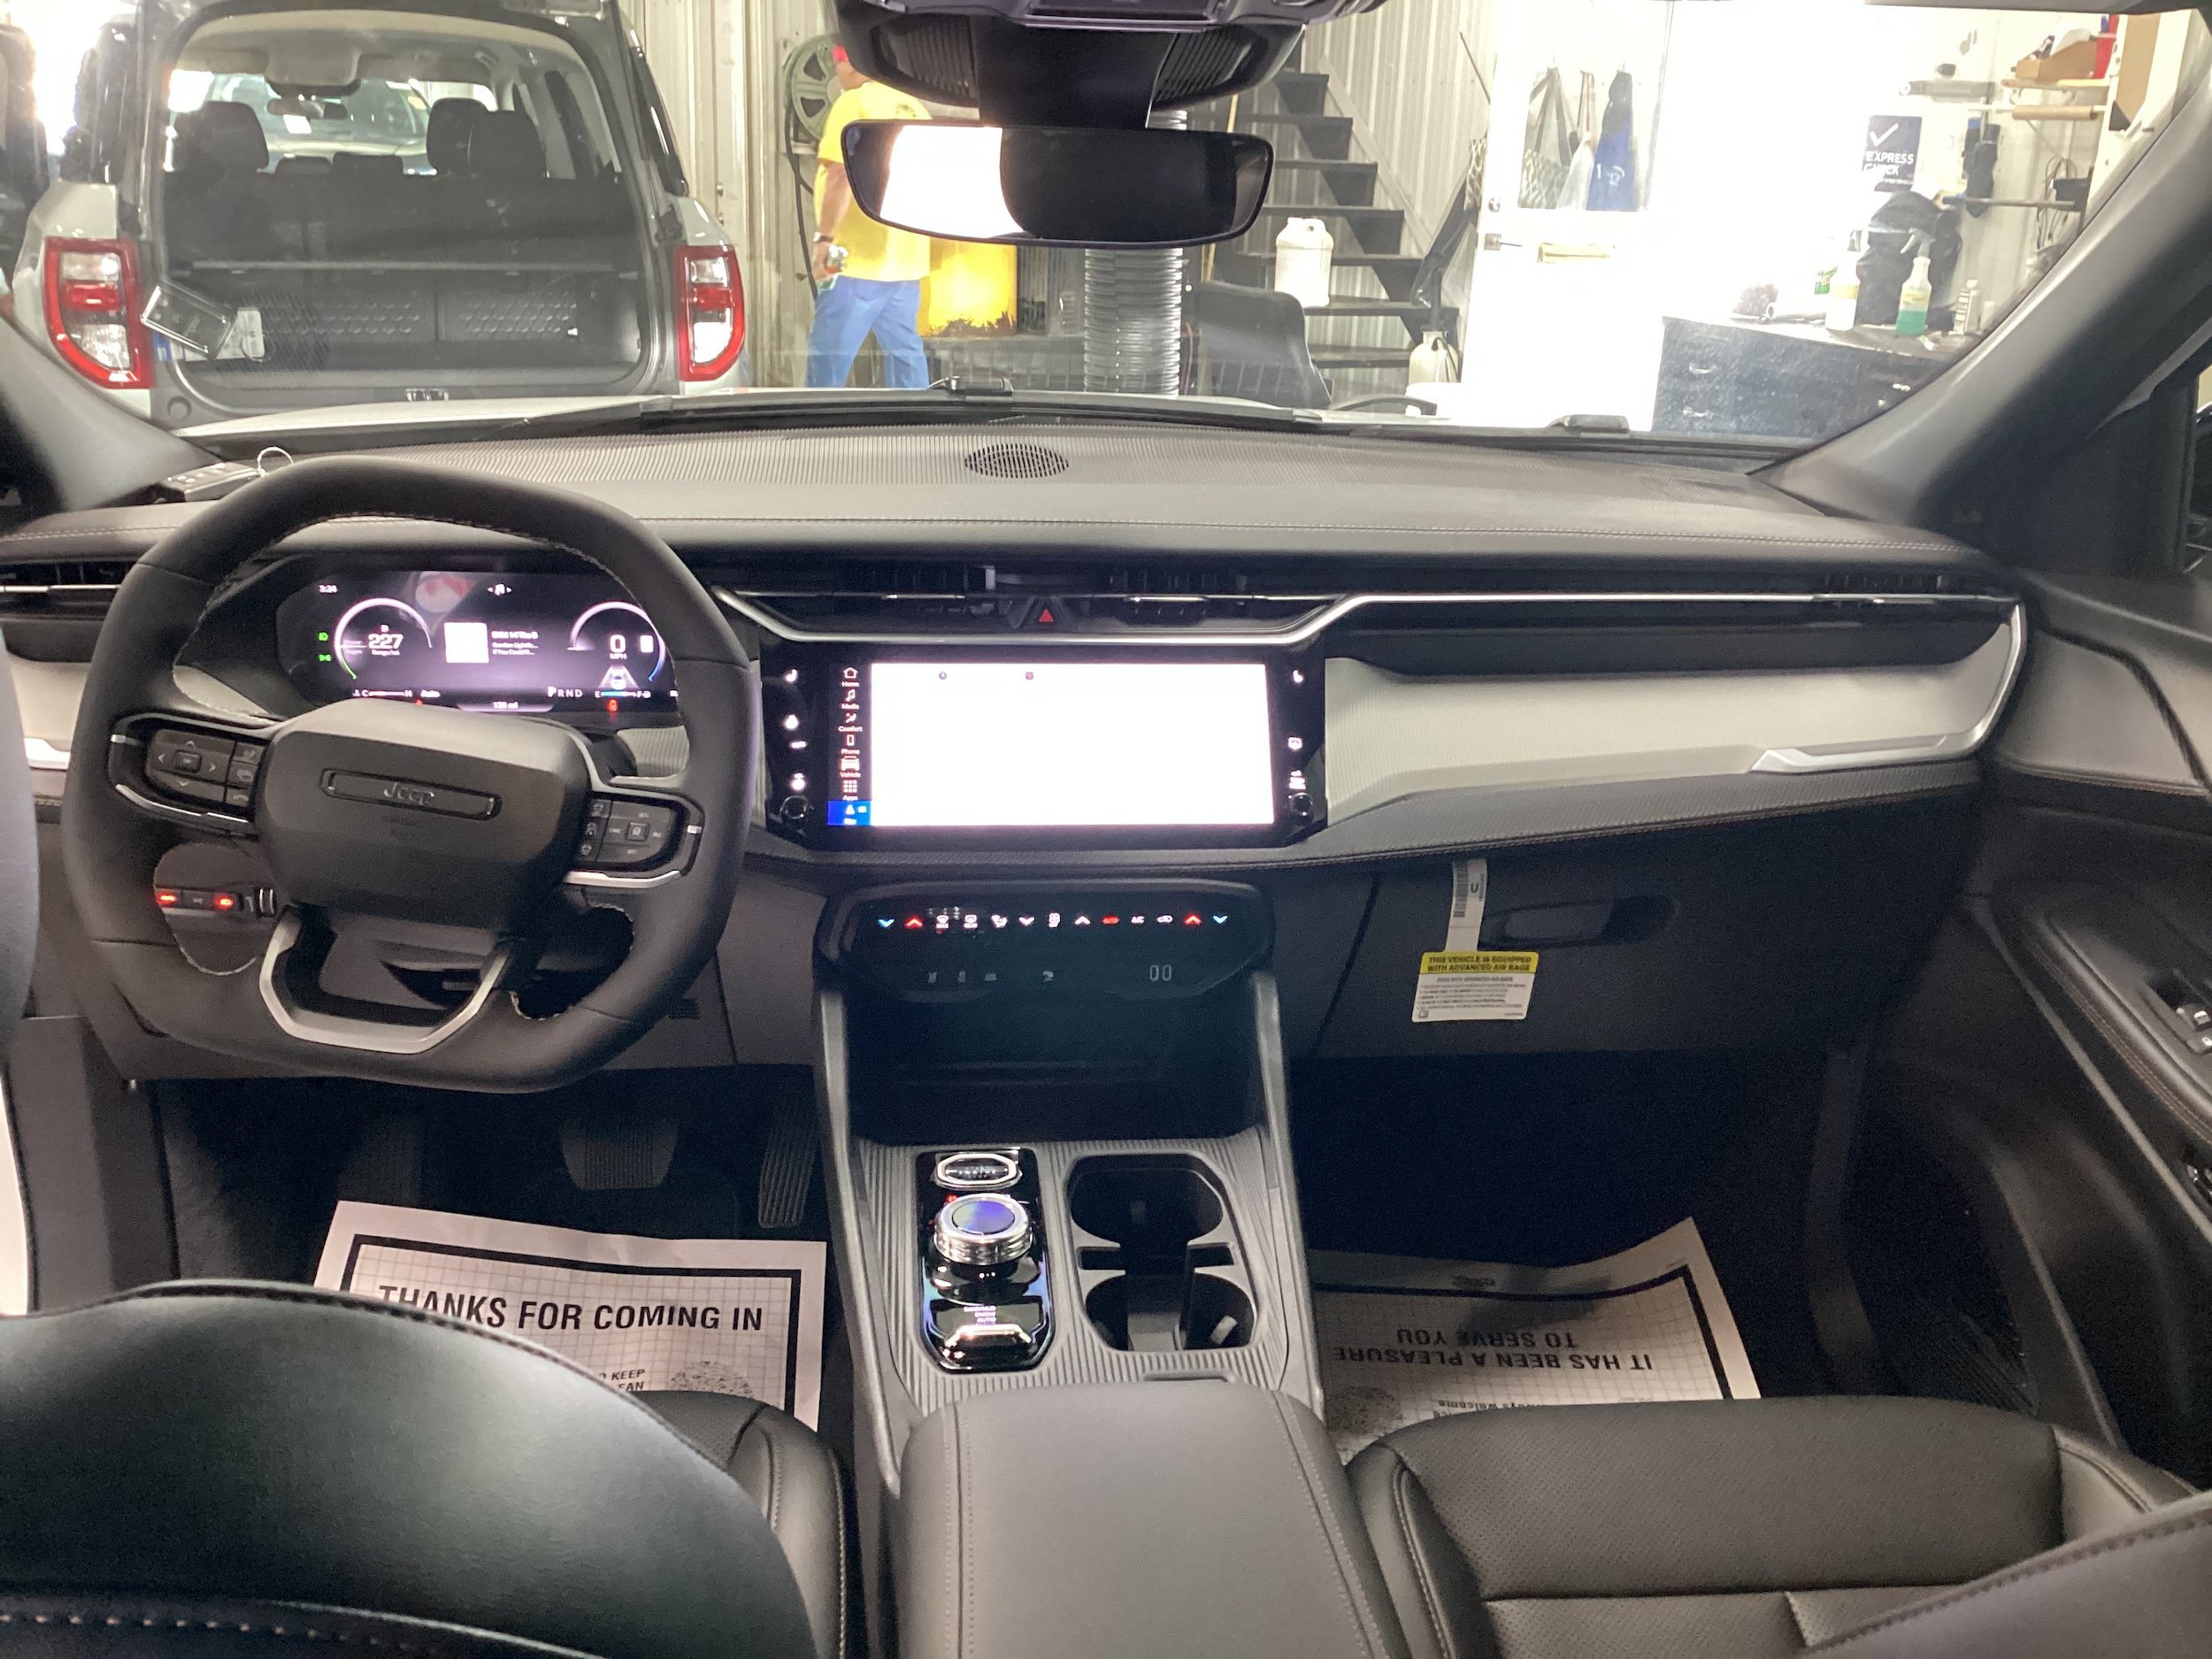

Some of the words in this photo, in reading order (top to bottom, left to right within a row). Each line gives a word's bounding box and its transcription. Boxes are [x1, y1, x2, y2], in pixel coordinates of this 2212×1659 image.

[1865, 150, 1914, 165] EXPRESS
[1863, 163, 1900, 176] CCK
[368, 634, 403, 649] 227
[610, 634, 626, 653] 0
[383, 782, 434, 806] Jeep
[379, 1285, 507, 1328] THANKS
[518, 1301, 582, 1330] FOR
[594, 1304, 720, 1330] COMING
[732, 1308, 762, 1331] IN
[1396, 1329, 1448, 1346] YOU
[1458, 1330, 1536, 1348] SERVE
[1545, 1332, 1578, 1348] TO
[1333, 1346, 1463, 1366] PLEASURE
[1471, 1352, 1487, 1367] A
[1495, 1353, 1561, 1369] BEEN
[1569, 1354, 1621, 1371] HAS
[1630, 1354, 1653, 1371] IT
[611, 1369, 646, 1380] KEEP
